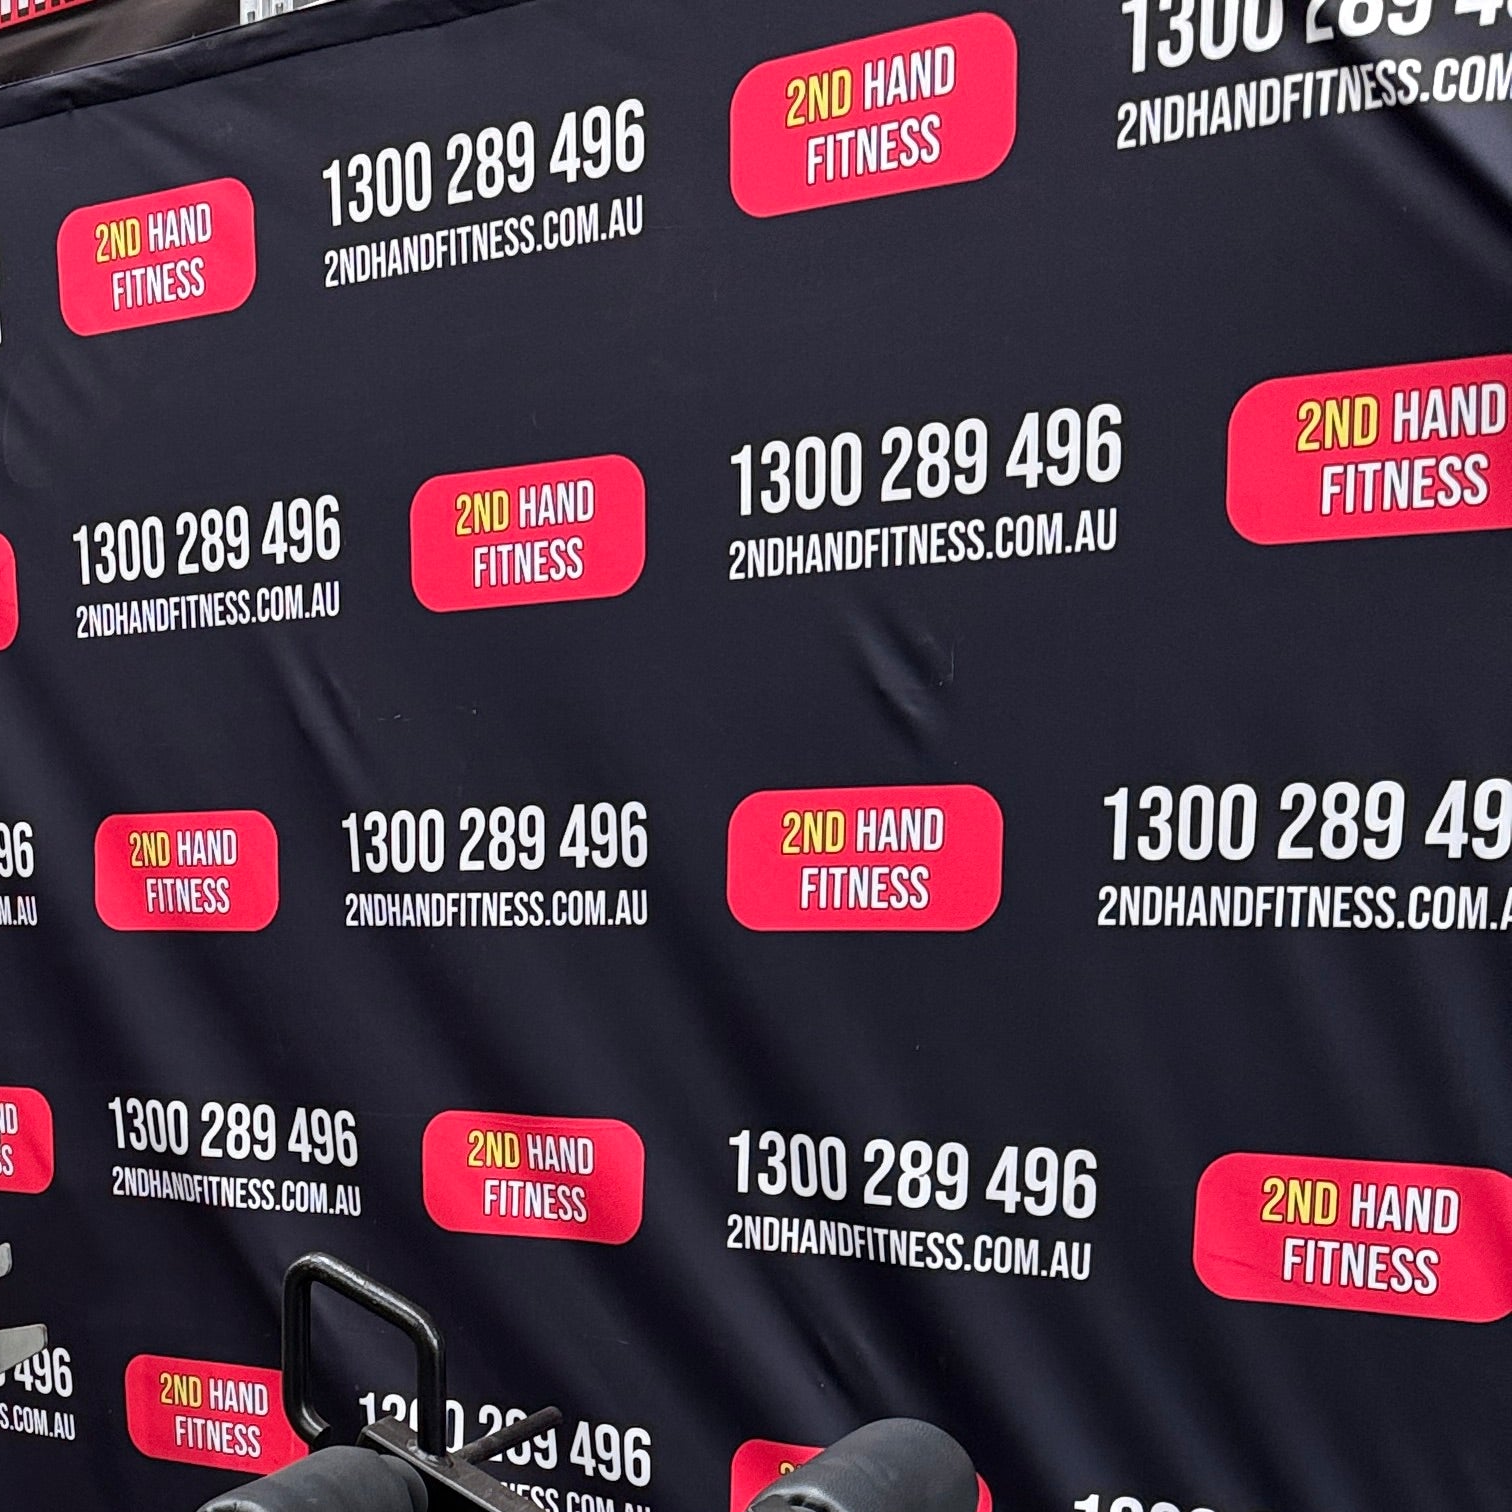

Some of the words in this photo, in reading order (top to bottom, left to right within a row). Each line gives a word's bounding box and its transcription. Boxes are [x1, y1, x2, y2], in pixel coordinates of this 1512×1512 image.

[785, 67, 852, 128] 2ND
[863, 44, 955, 108] HAND
[322, 141, 432, 227] 1300
[444, 121, 536, 205] 289
[548, 97, 646, 184] 496
[806, 115, 941, 186] FITNESS
[95, 217, 141, 264] 2ND
[147, 203, 213, 251] HAND
[323, 195, 645, 288] 2NDHANDFITNESS.COM.AU
[111, 257, 206, 312] FITNESS
[1296, 394, 1379, 452] 2ND
[1392, 382, 1507, 443] HAND
[730, 432, 864, 516] 1300
[879, 417, 989, 503] 289
[1005, 403, 1124, 488] 496
[1320, 452, 1490, 515] FITNESS
[454, 489, 510, 536] 2ND
[518, 479, 595, 527] HAND
[72, 516, 165, 587] 1300
[174, 505, 251, 578] 289
[261, 494, 342, 564] 496
[473, 537, 584, 588] FITNESS
[728, 508, 1118, 581] 2NDHANDFITNESS.COM.AU
[75, 580, 341, 639] 2NDHANDFITNESS.COM.AU
[129, 831, 171, 869] 2ND
[176, 828, 237, 867] HAND
[341, 809, 445, 875] 1300
[458, 805, 546, 871] 289
[559, 801, 648, 869] 496
[781, 809, 846, 856] 2ND
[855, 807, 945, 853] HAND
[1103, 784, 1258, 861] 1300
[1277, 780, 1406, 860] 289
[145, 876, 230, 915] FITNESS
[345, 890, 648, 928] 2NDHANDFITNESS.COM.AU
[799, 865, 930, 911] FITNESS
[108, 1096, 189, 1156] 1300
[200, 1101, 277, 1162] 289
[287, 1107, 359, 1168] 496
[467, 1129, 521, 1169] 2ND
[527, 1132, 594, 1175] HAND
[112, 1165, 362, 1218] 2NDHANDFITNESS.COM.AU
[483, 1177, 588, 1223] FITNESS
[728, 1128, 847, 1202] 1300
[863, 1137, 970, 1214] 289
[985, 1146, 1098, 1220] 496
[1260, 1176, 1338, 1227] 2ND
[1350, 1184, 1461, 1236] HAND
[727, 1214, 1092, 1282] 2NDHANDFITNESS.COM.AU
[1281, 1238, 1441, 1297] FITNESS
[159, 1371, 203, 1408] 2ND
[208, 1379, 269, 1417] HAND
[174, 1413, 262, 1459] FITNESS
[569, 1420, 652, 1488] 496
